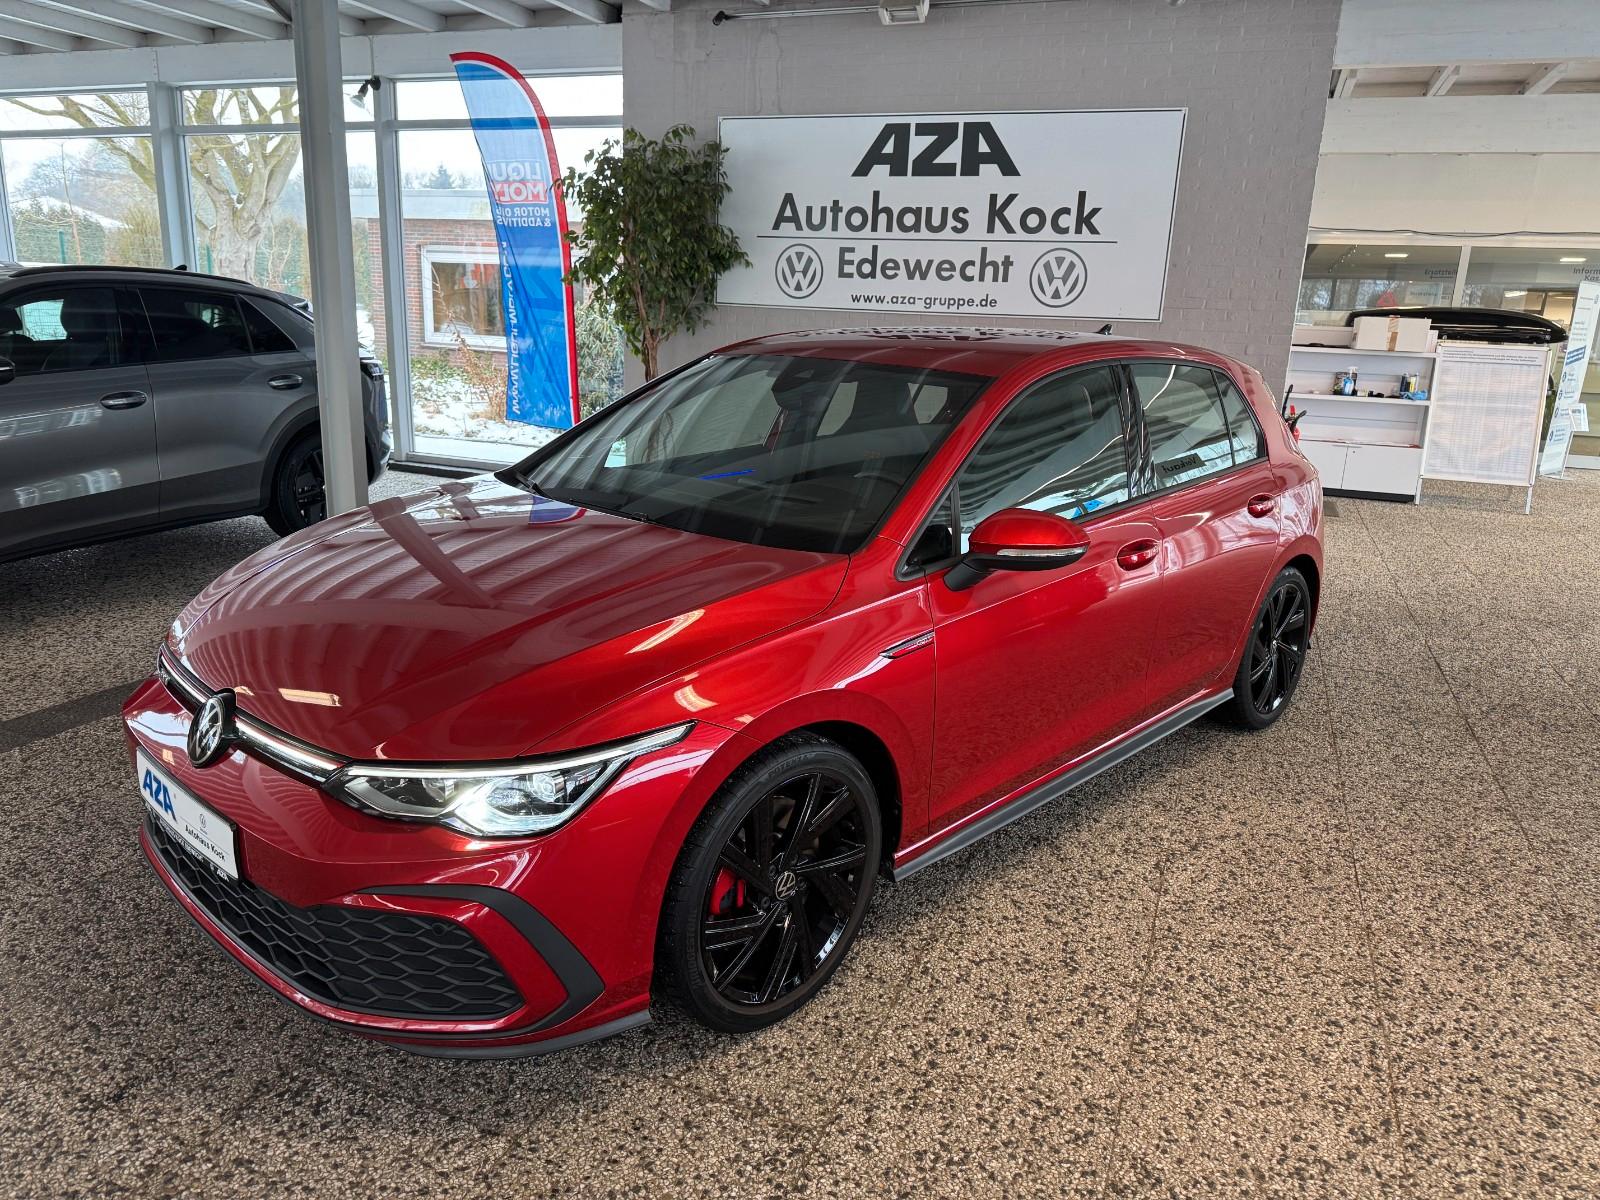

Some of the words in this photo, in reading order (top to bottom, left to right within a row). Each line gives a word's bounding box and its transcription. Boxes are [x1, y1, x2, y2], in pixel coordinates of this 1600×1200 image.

[851, 121, 1021, 177] AZA
[771, 191, 969, 234] Autohaus
[986, 191, 1103, 236] Kock
[837, 246, 1014, 283] Edewecht
[851, 293, 998, 310] www.aza-gruppe.de
[143, 768, 178, 823] AZA
